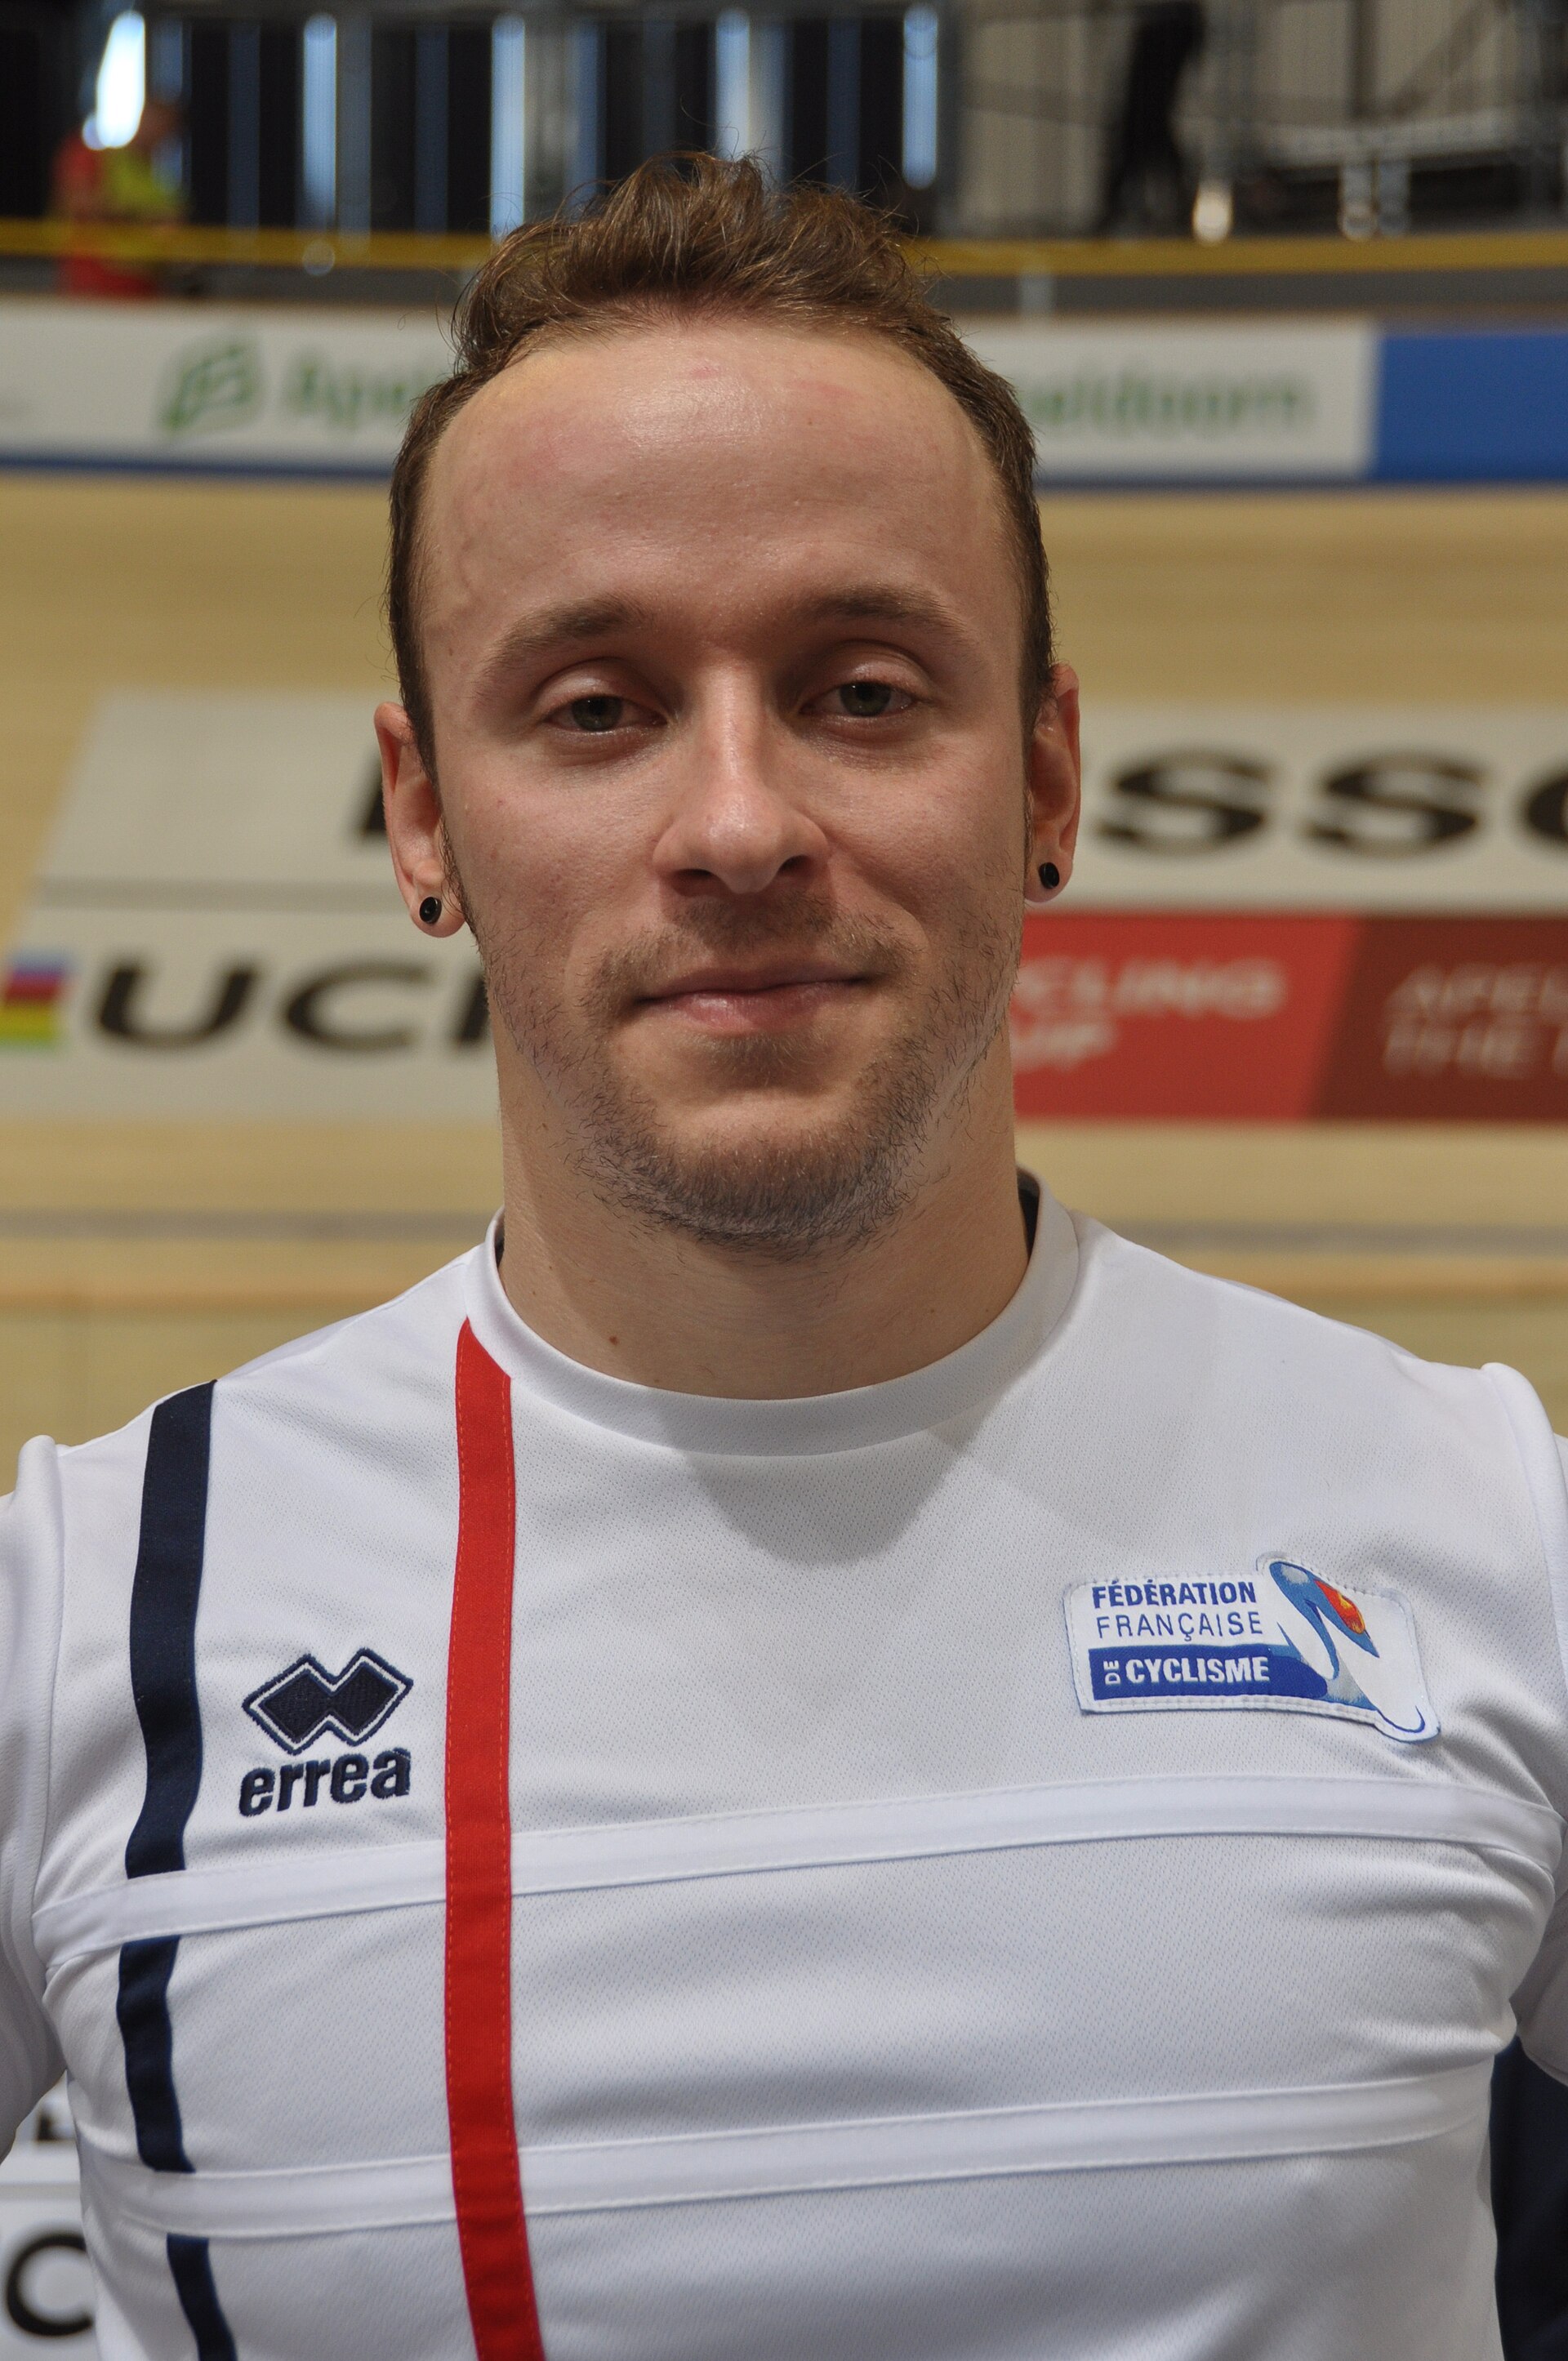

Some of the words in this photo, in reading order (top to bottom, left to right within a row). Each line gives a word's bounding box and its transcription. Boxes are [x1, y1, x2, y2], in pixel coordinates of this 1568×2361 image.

[1091, 1579, 1257, 1610] FÉDÉRATION
[1096, 1610, 1263, 1642] FRANÇAISE
[1125, 1655, 1271, 1685] CYCLISME
